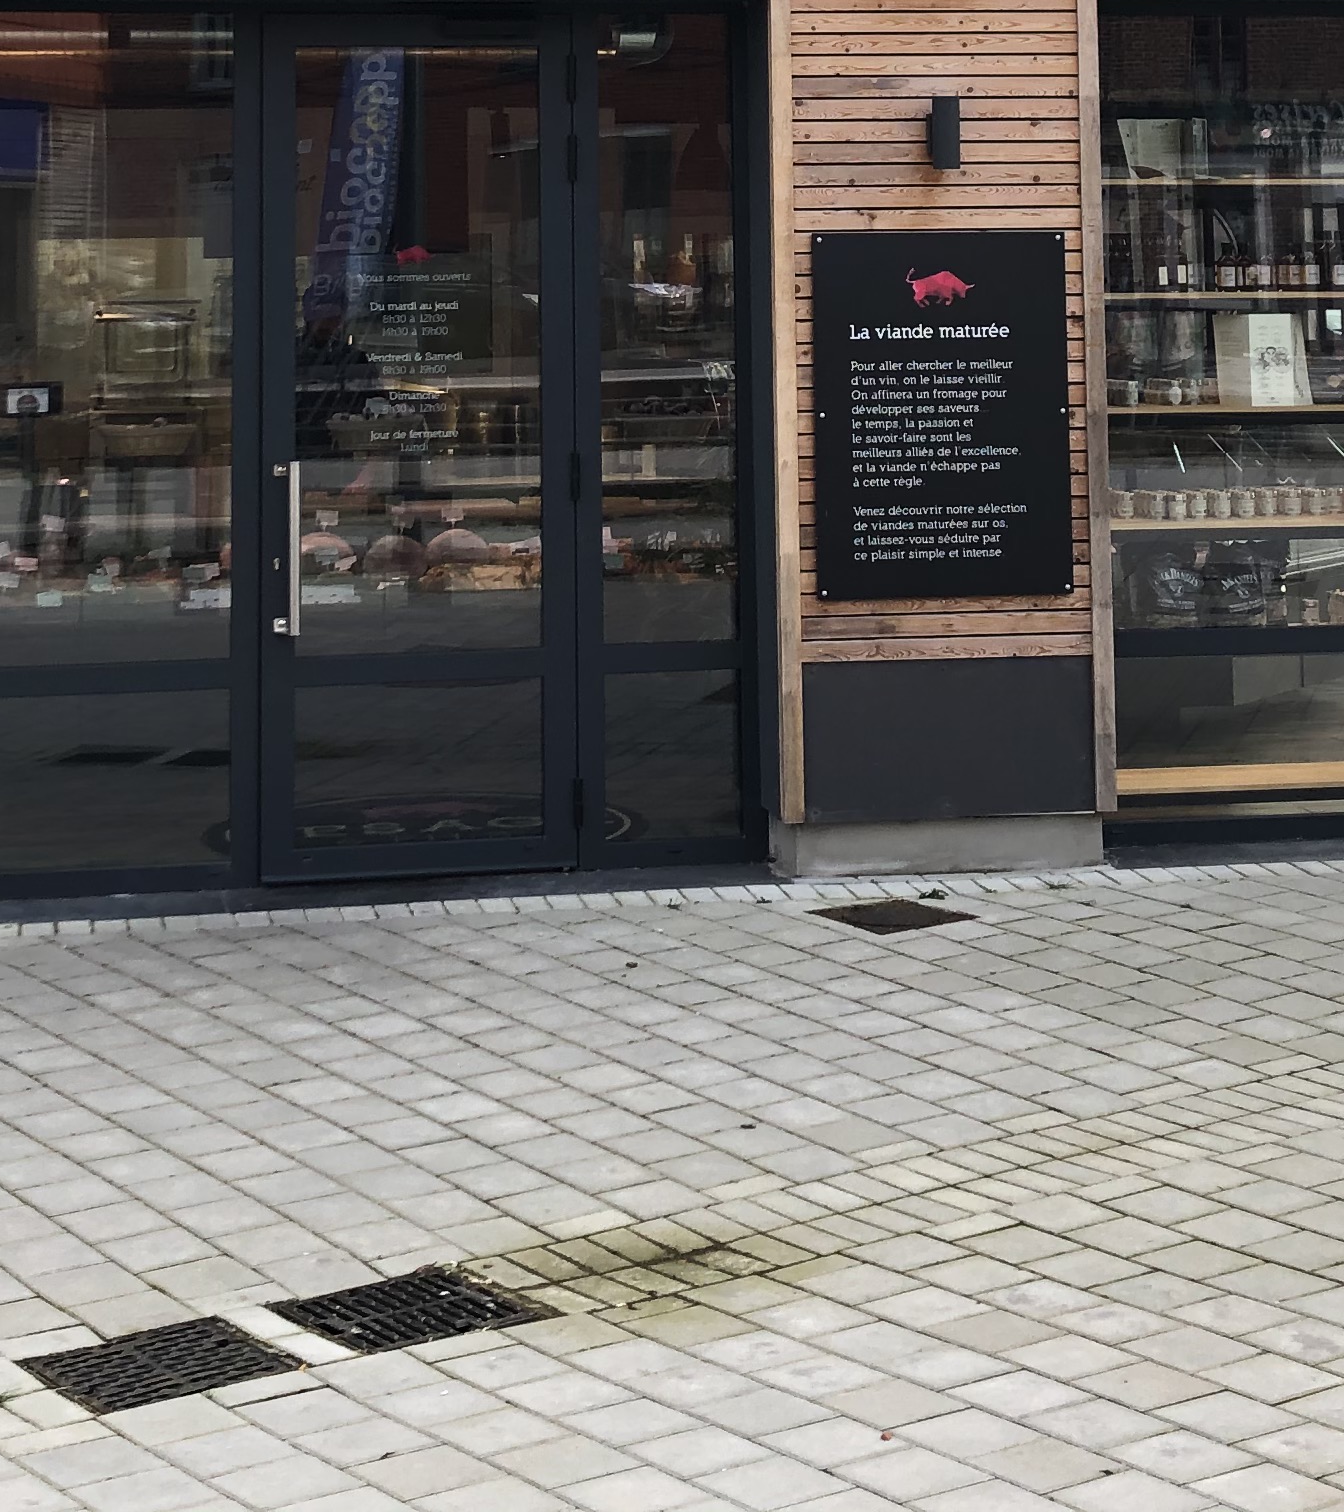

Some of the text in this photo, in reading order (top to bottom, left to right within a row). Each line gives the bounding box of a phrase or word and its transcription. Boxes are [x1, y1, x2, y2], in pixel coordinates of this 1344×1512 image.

[387, 274, 430, 283] sommes
[432, 273, 471, 281] ouverts
[370, 300, 459, 312] Du mardi au jeudi
[419, 314, 447, 323] 12h30
[421, 326, 449, 336] 19h00
[850, 323, 1009, 339] La viande maturée
[366, 351, 464, 362] Vendredi & Samedi
[851, 359, 1013, 371] Pour aller chercher le meilleur
[851, 376, 876, 385] d'un
[903, 376, 917, 385] on
[920, 375, 930, 384] le
[933, 375, 964, 384] laisse
[389, 391, 440, 400] Dimanche
[852, 389, 1007, 400] On affinera un fromage pour
[852, 404, 913, 416] développer
[917, 405, 934, 413] ses
[852, 419, 862, 429] le
[905, 418, 915, 428] la
[918, 420, 960, 430] passion
[963, 418, 973, 428] et
[370, 429, 459, 442] Jour de fermeture
[852, 432, 971, 443] le savoir-faire sont les
[400, 442, 429, 452] Lundi
[852, 448, 902, 458] meilleurs
[906, 447, 933, 456] alliés
[937, 446, 951, 456] de
[853, 460, 1000, 473] et la viande n'échappe pas
[853, 477, 859, 487] à
[863, 478, 890, 487] cette
[853, 503, 1027, 516] Venez découvrir notre sélection
[854, 521, 868, 530] de
[871, 520, 914, 530] viandes
[918, 519, 968, 529] maturées
[972, 520, 989, 529] sur
[854, 533, 1001, 546] et laissez-vous séduire par
[854, 552, 867, 561] ce
[871, 550, 905, 562] plaisir
[909, 548, 945, 560] simple
[949, 549, 959, 558] et
